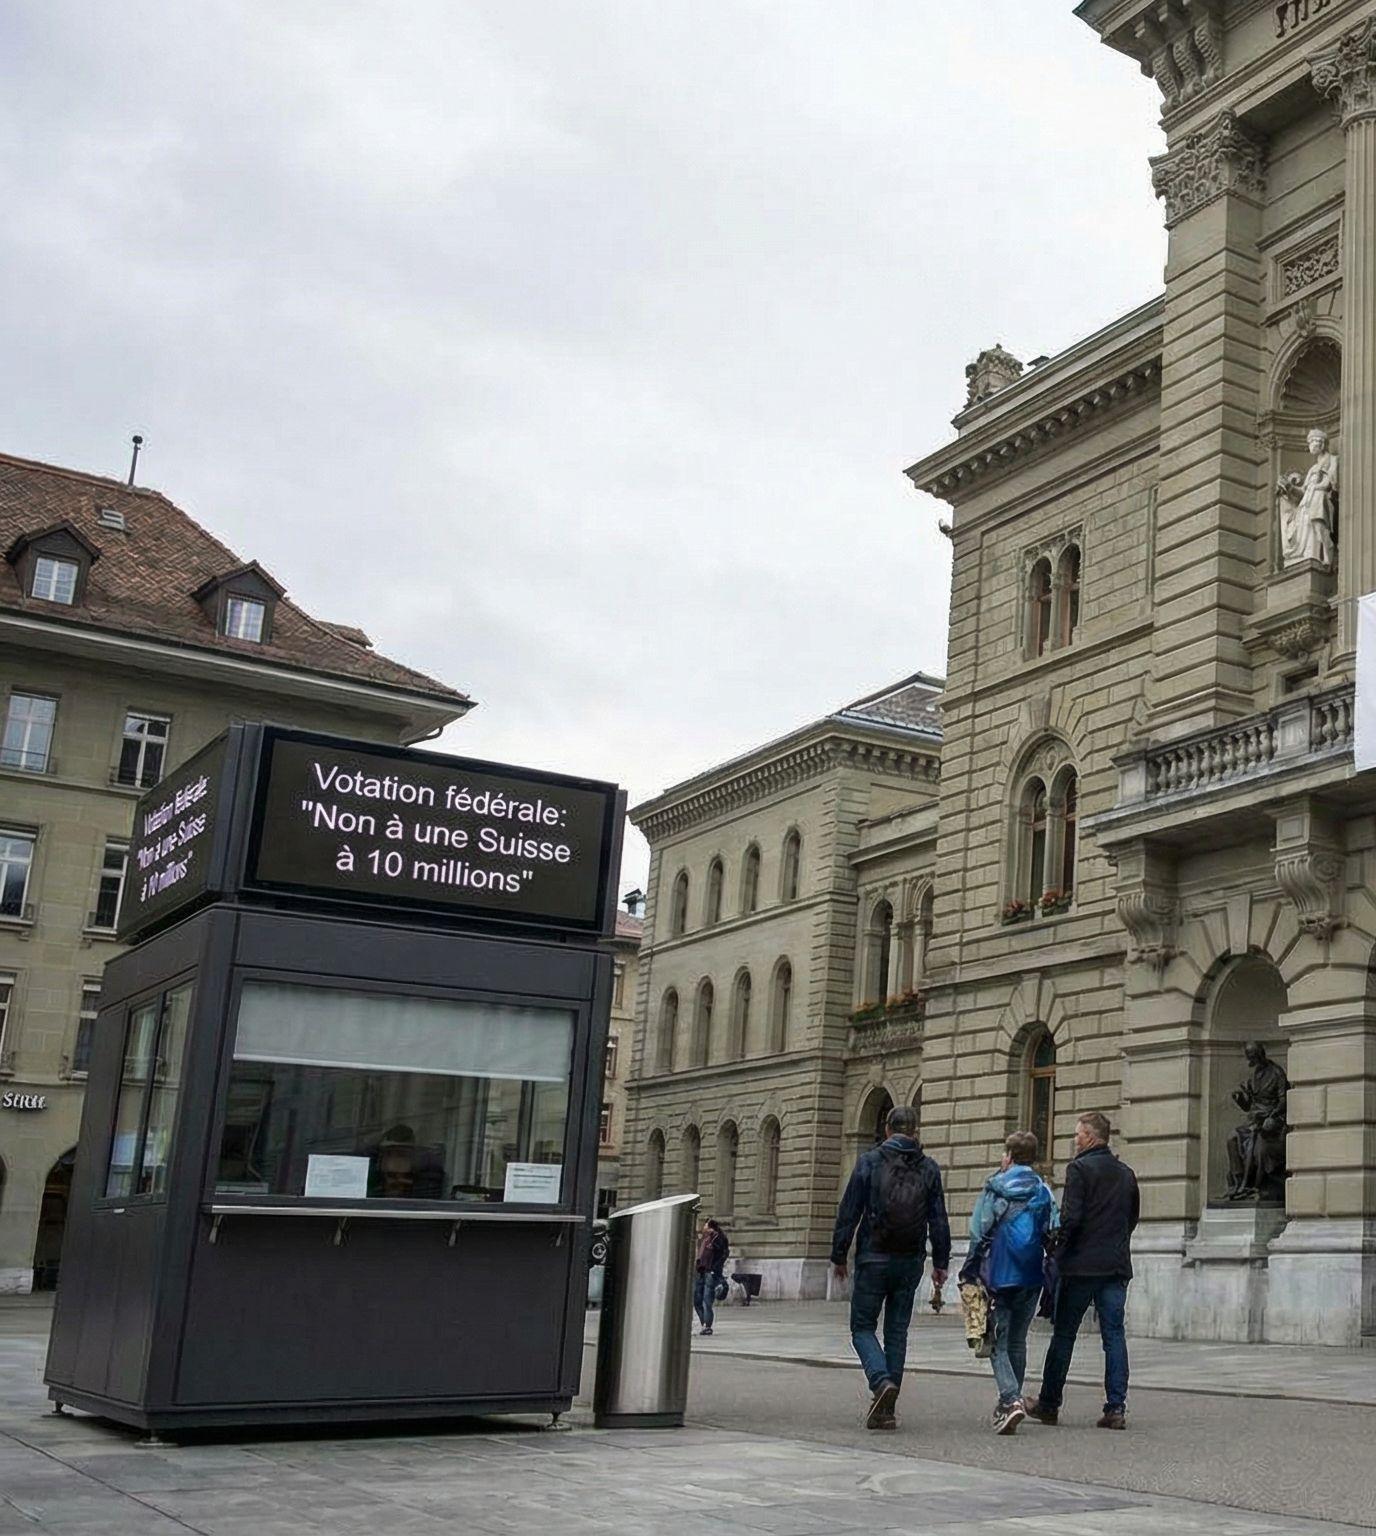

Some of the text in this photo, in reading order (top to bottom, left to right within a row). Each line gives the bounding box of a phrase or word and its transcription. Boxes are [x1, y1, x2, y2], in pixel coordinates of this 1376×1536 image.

[314, 762, 568, 828] Votation fédérale:
[301, 799, 572, 864] "Non à une Suisse
[335, 844, 535, 894] à 10 millions"
